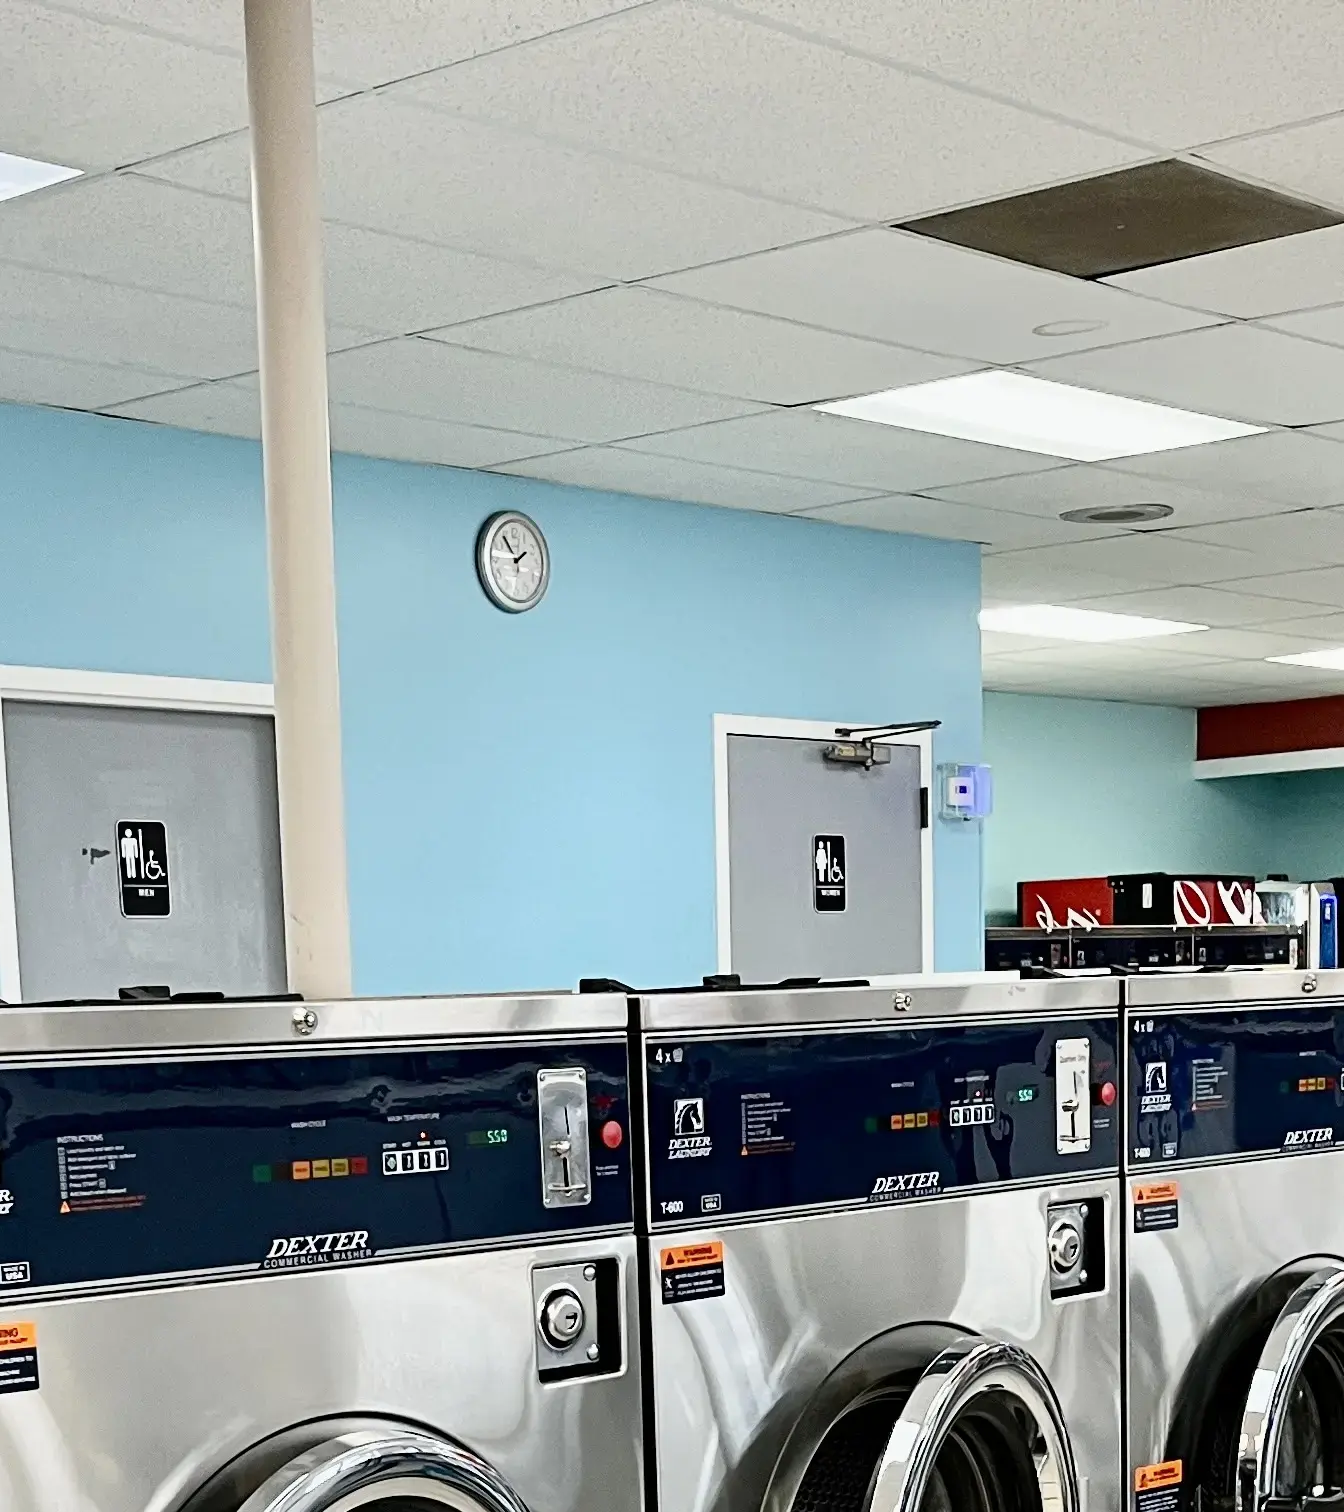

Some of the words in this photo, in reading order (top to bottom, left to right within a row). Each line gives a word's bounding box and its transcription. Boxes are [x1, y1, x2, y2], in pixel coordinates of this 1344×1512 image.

[655, 1048, 663, 1063] 4
[668, 1136, 712, 1150] DEXTER
[1284, 1127, 1333, 1146] DEXTER
[871, 1171, 940, 1194] DEXTER
[266, 1230, 369, 1259] DEXTER
[263, 1253, 329, 1269] COMMERCIAL
[332, 1248, 372, 1261] WASHER
